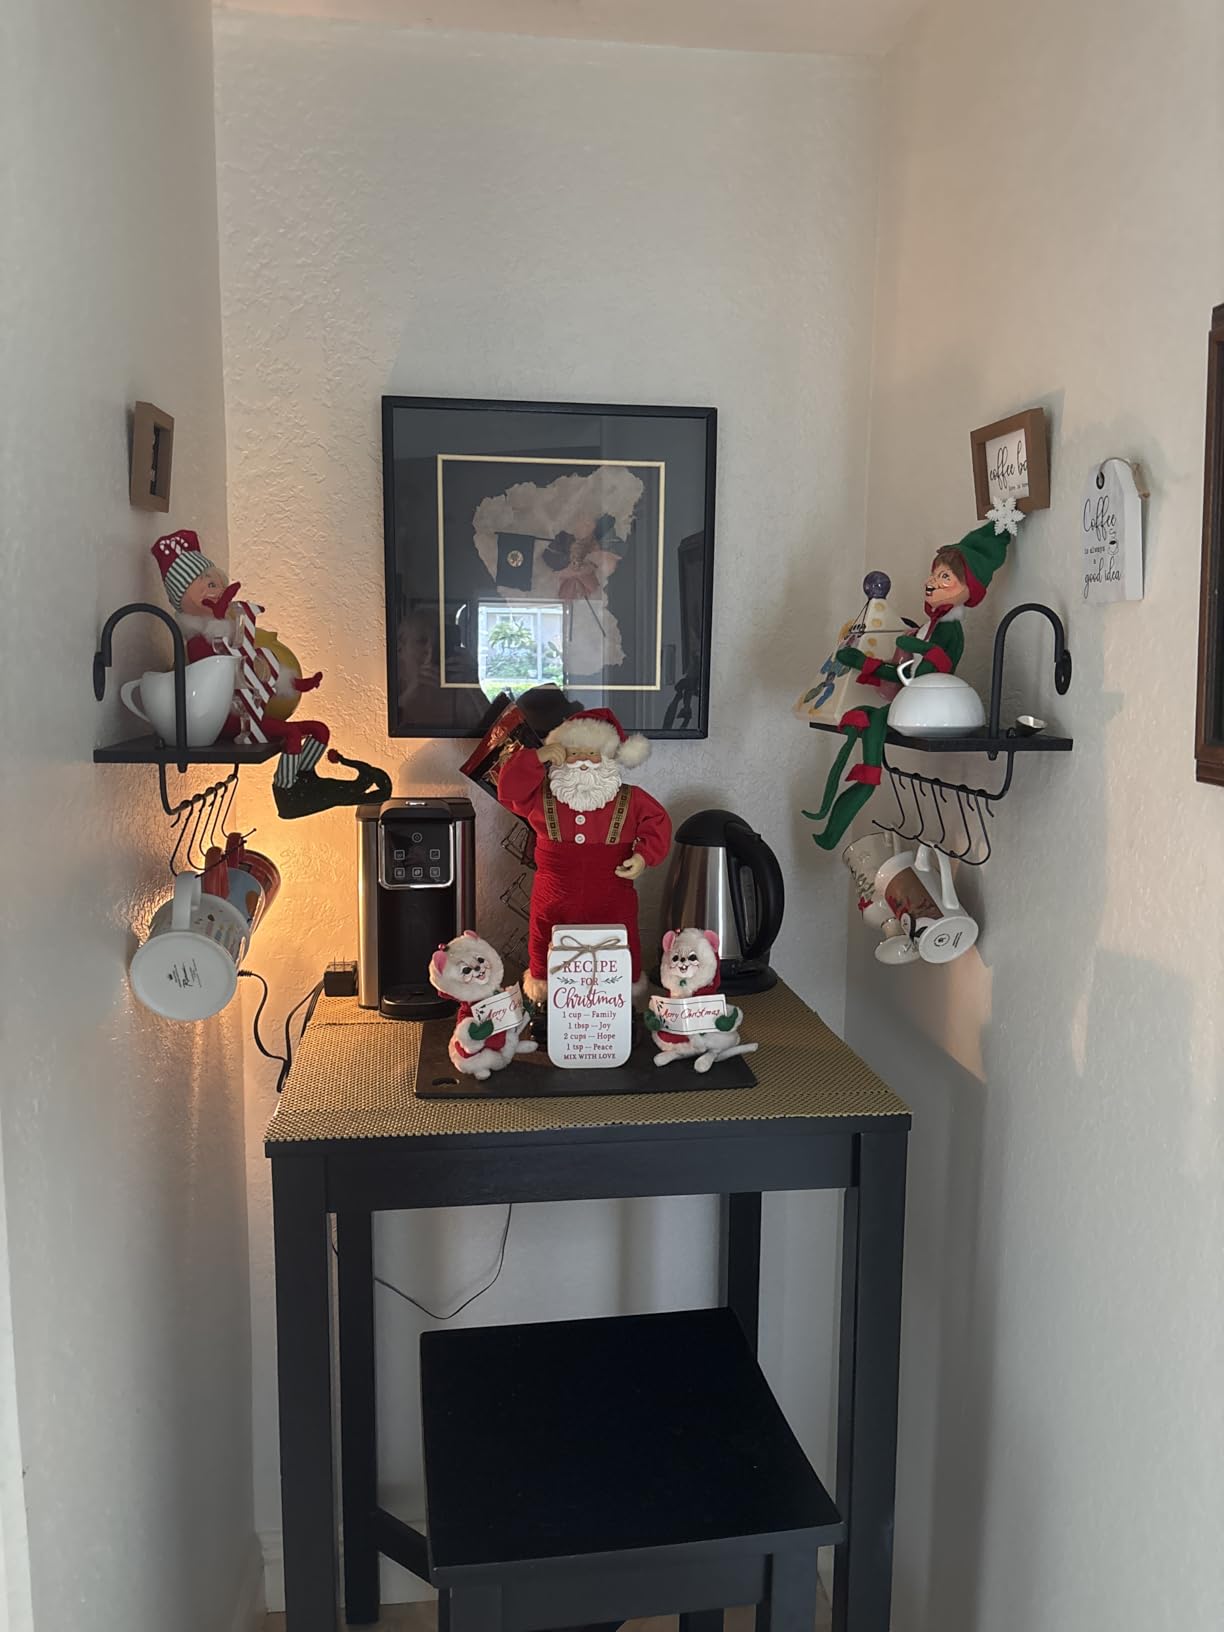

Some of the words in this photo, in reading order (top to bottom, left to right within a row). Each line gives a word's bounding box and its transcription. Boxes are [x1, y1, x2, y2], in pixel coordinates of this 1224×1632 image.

[990, 446, 1015, 490] coffee
[1083, 495, 1116, 542] Coffee
[1084, 557, 1104, 599] good
[1105, 556, 1120, 581] idea
[563, 960, 618, 973] RECIPE
[581, 977, 599, 986] FOR
[553, 986, 626, 1009] Christmas
[568, 1012, 582, 1020] cup
[592, 1011, 616, 1020] Family
[662, 1009, 679, 1022] Merry
[680, 1007, 720, 1019] Christmas
[574, 1022, 589, 1031] tbsp
[599, 1022, 610, 1031] Joy
[597, 1033, 616, 1041] Hope
[573, 1044, 584, 1052] tsp
